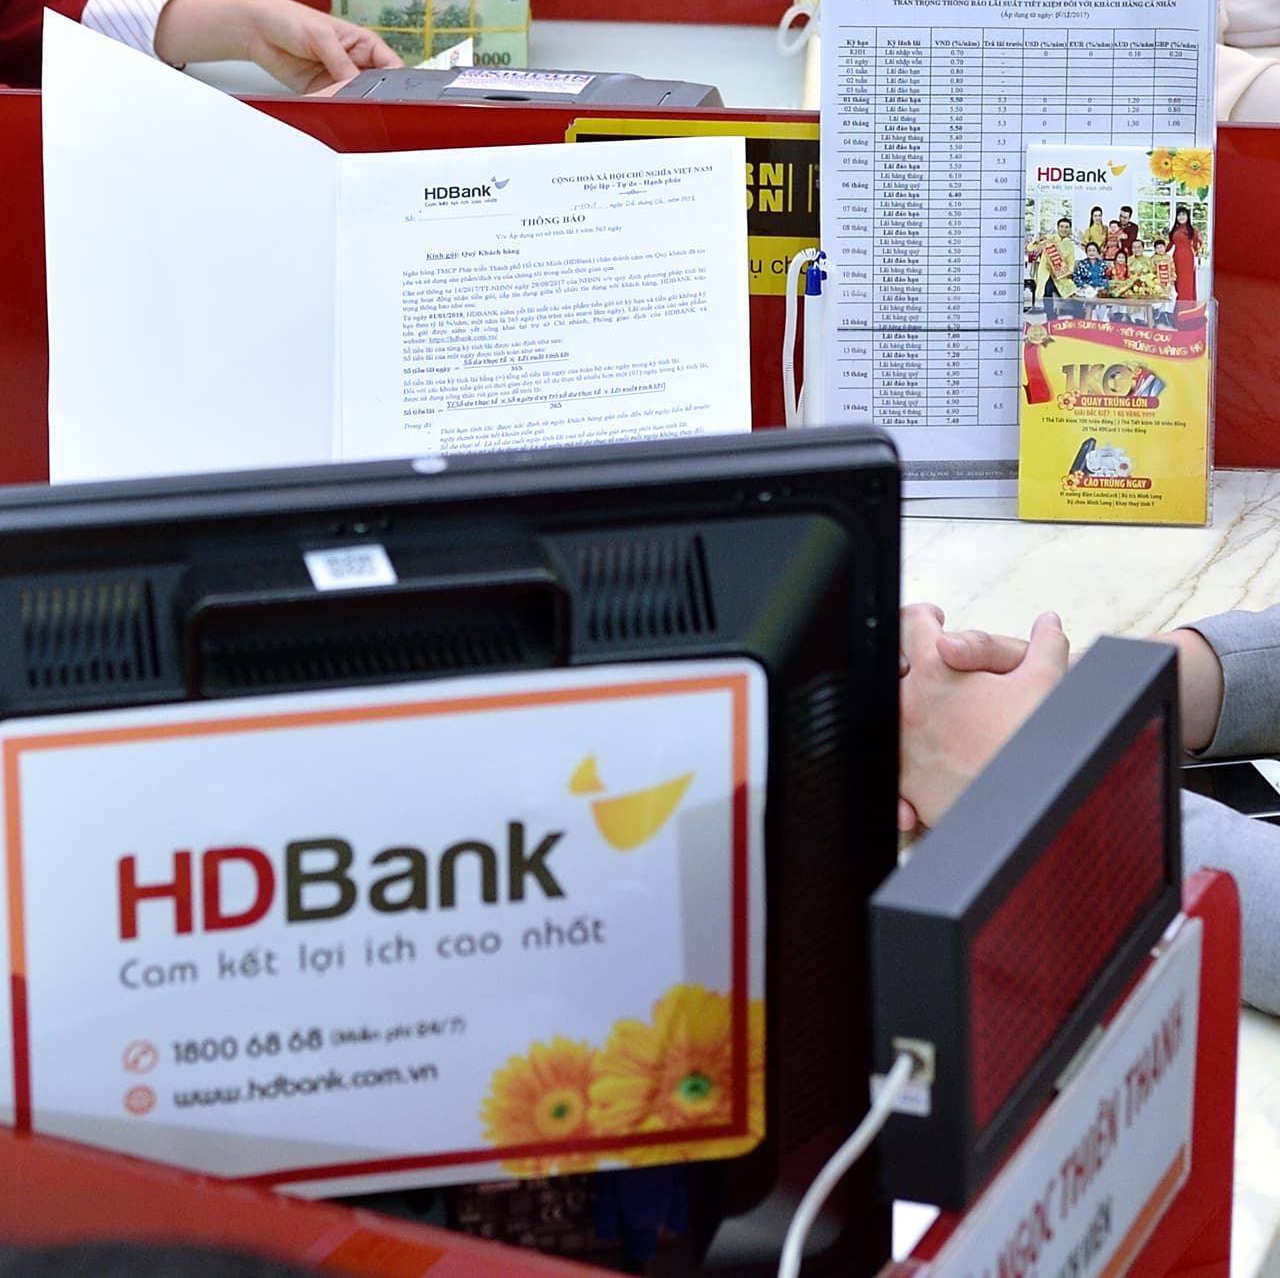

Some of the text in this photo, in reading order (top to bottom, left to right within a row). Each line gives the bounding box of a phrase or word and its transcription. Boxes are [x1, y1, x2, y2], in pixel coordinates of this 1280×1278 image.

[1094, 0, 1121, 8] KHÁCH
[1122, 0, 1143, 8] HÀNG
[1156, 0, 1176, 8] NHÂN
[1037, 167, 1107, 183] HDBank
[424, 185, 491, 200] HDBank
[521, 214, 585, 227] THÔNG BÁO
[1081, 398, 1102, 407] QUAY
[1127, 478, 1147, 488] NGAY
[116, 819, 567, 943] HDBank
[119, 959, 198, 990] Cam
[218, 946, 279, 981] kết
[298, 943, 345, 974] lợi
[435, 932, 502, 960] cao
[521, 915, 606, 951] nhất
[171, 1036, 239, 1067] 1800
[246, 1032, 280, 1059] 68
[288, 1029, 323, 1055] 68
[172, 1061, 439, 1111] www.hdbank.com.vn
